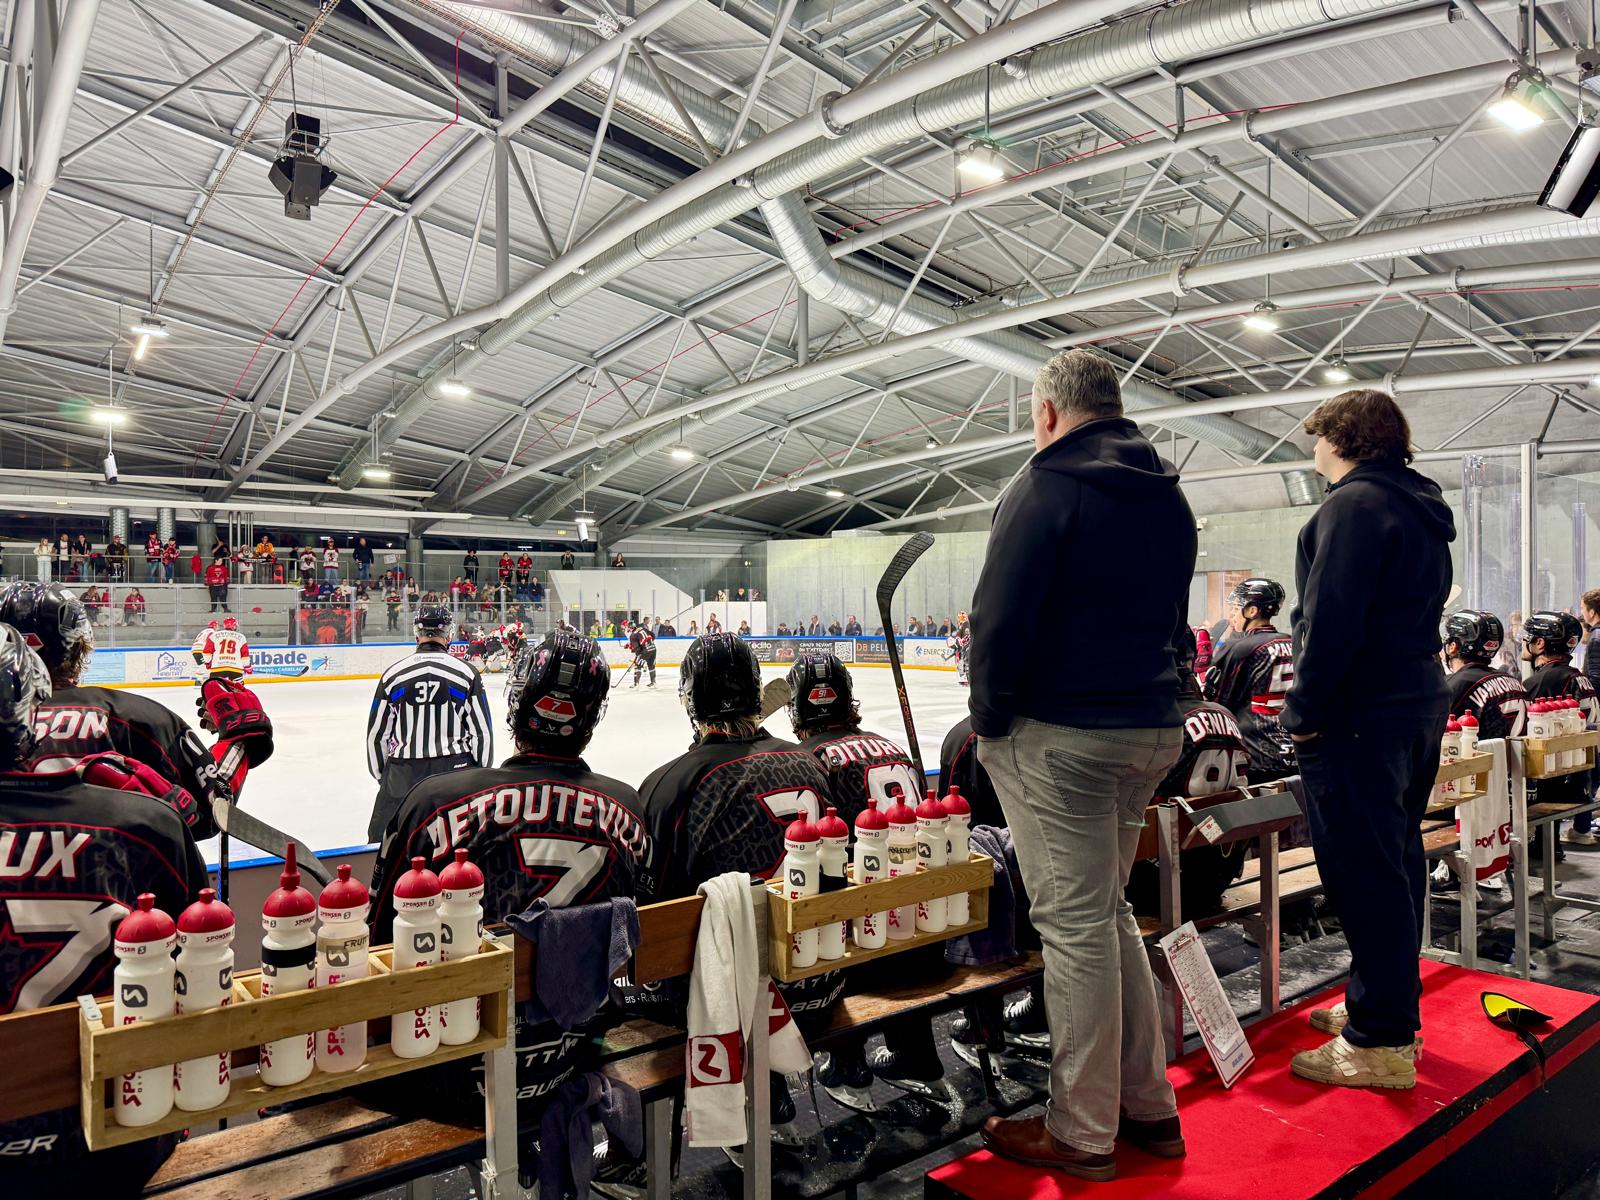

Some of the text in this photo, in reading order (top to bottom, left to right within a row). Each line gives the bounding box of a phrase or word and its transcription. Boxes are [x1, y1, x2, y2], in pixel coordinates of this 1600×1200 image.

[220, 639, 236, 654] 19
[870, 643, 903, 652] PELLS
[415, 681, 440, 703] 37
[551, 701, 562, 710] 7
[518, 838, 611, 908] 7
[5, 899, 132, 1013] 7
